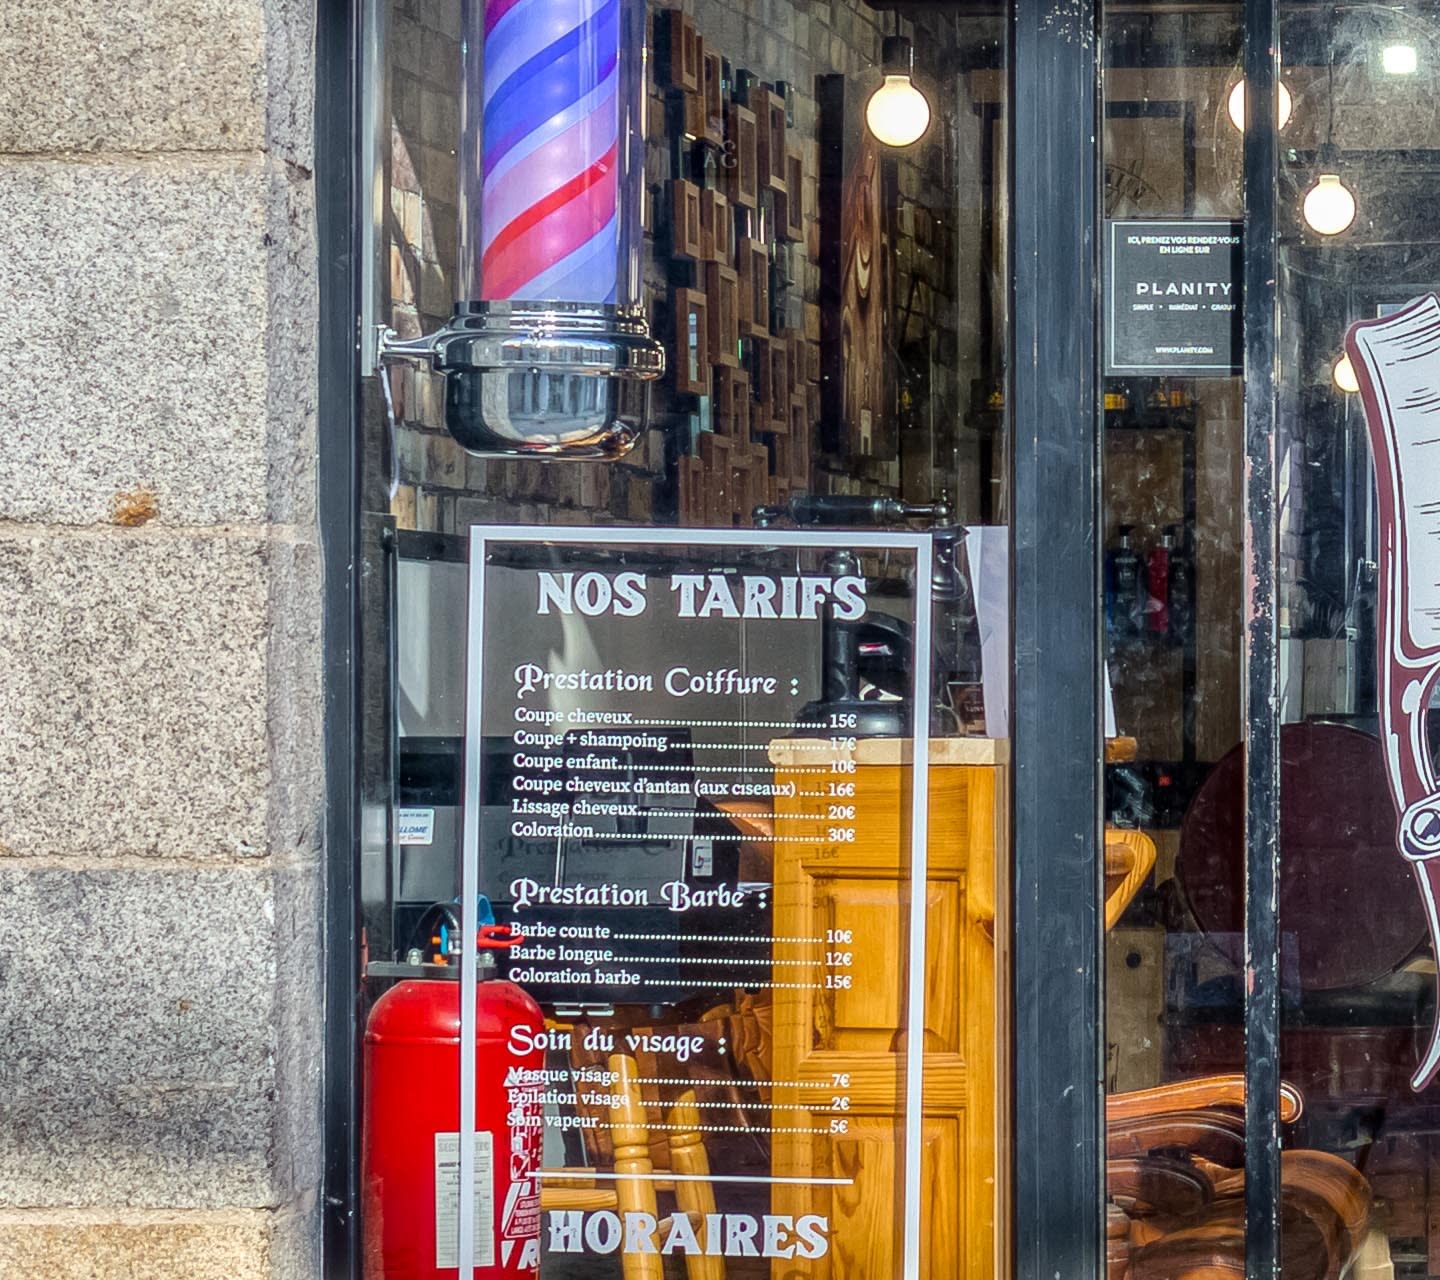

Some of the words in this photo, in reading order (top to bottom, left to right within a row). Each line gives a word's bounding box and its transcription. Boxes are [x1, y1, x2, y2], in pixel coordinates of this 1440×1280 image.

[1141, 236, 1170, 245] PRENEZ
[1170, 236, 1187, 245] VOS
[1187, 236, 1240, 245] RENDEZ-VOUS
[1159, 246, 1171, 254] EN
[1172, 246, 1194, 254] LIGNE
[1194, 246, 1211, 254] SUR
[1136, 282, 1233, 296] PLANITY
[537, 571, 647, 616] NOS
[670, 573, 868, 621] TARIFS
[513, 663, 654, 699] Prestation
[665, 667, 778, 697] Coiffure
[514, 706, 564, 728] Coupe
[567, 708, 633, 726] cheveux
[829, 713, 858, 730] 15€
[513, 729, 564, 750] Coupe
[579, 731, 668, 753] shampoing
[829, 736, 858, 752] 17€
[513, 752, 564, 773] Coupe
[566, 751, 619, 770] enfant
[829, 758, 857, 775] 10€
[512, 775, 563, 796] Coupe
[564, 775, 631, 794] cheveux
[693, 778, 729, 799] (aux
[828, 782, 856, 798] 16€
[511, 797, 570, 819] Lissage
[572, 799, 638, 817] cheveux
[828, 805, 856, 822] 20€
[511, 821, 594, 840] Coloration
[827, 827, 856, 844] 30€
[509, 877, 649, 913] Prestation
[659, 880, 746, 912] Barbe
[509, 922, 554, 940] Barbe
[825, 928, 853, 945] 10€
[509, 944, 554, 963] Barbe
[558, 945, 613, 967] longue
[825, 951, 853, 968] 12€
[508, 967, 592, 987] Coloration
[594, 969, 642, 987] barbe
[824, 974, 853, 991] 15€
[506, 1023, 573, 1058] Soin
[583, 1026, 615, 1054] du
[626, 1031, 704, 1062] visage
[507, 1066, 569, 1087] Masque
[572, 1067, 621, 1088] visage
[831, 1072, 851, 1089] 7€
[507, 1088, 578, 1109] Epilation
[580, 1089, 630, 1110] visage
[830, 1096, 851, 1113] 2€
[506, 1111, 542, 1128] Soin
[545, 1114, 600, 1132] vapeur
[829, 1118, 849, 1134] 5€
[547, 1209, 830, 1260] HORAIRES
